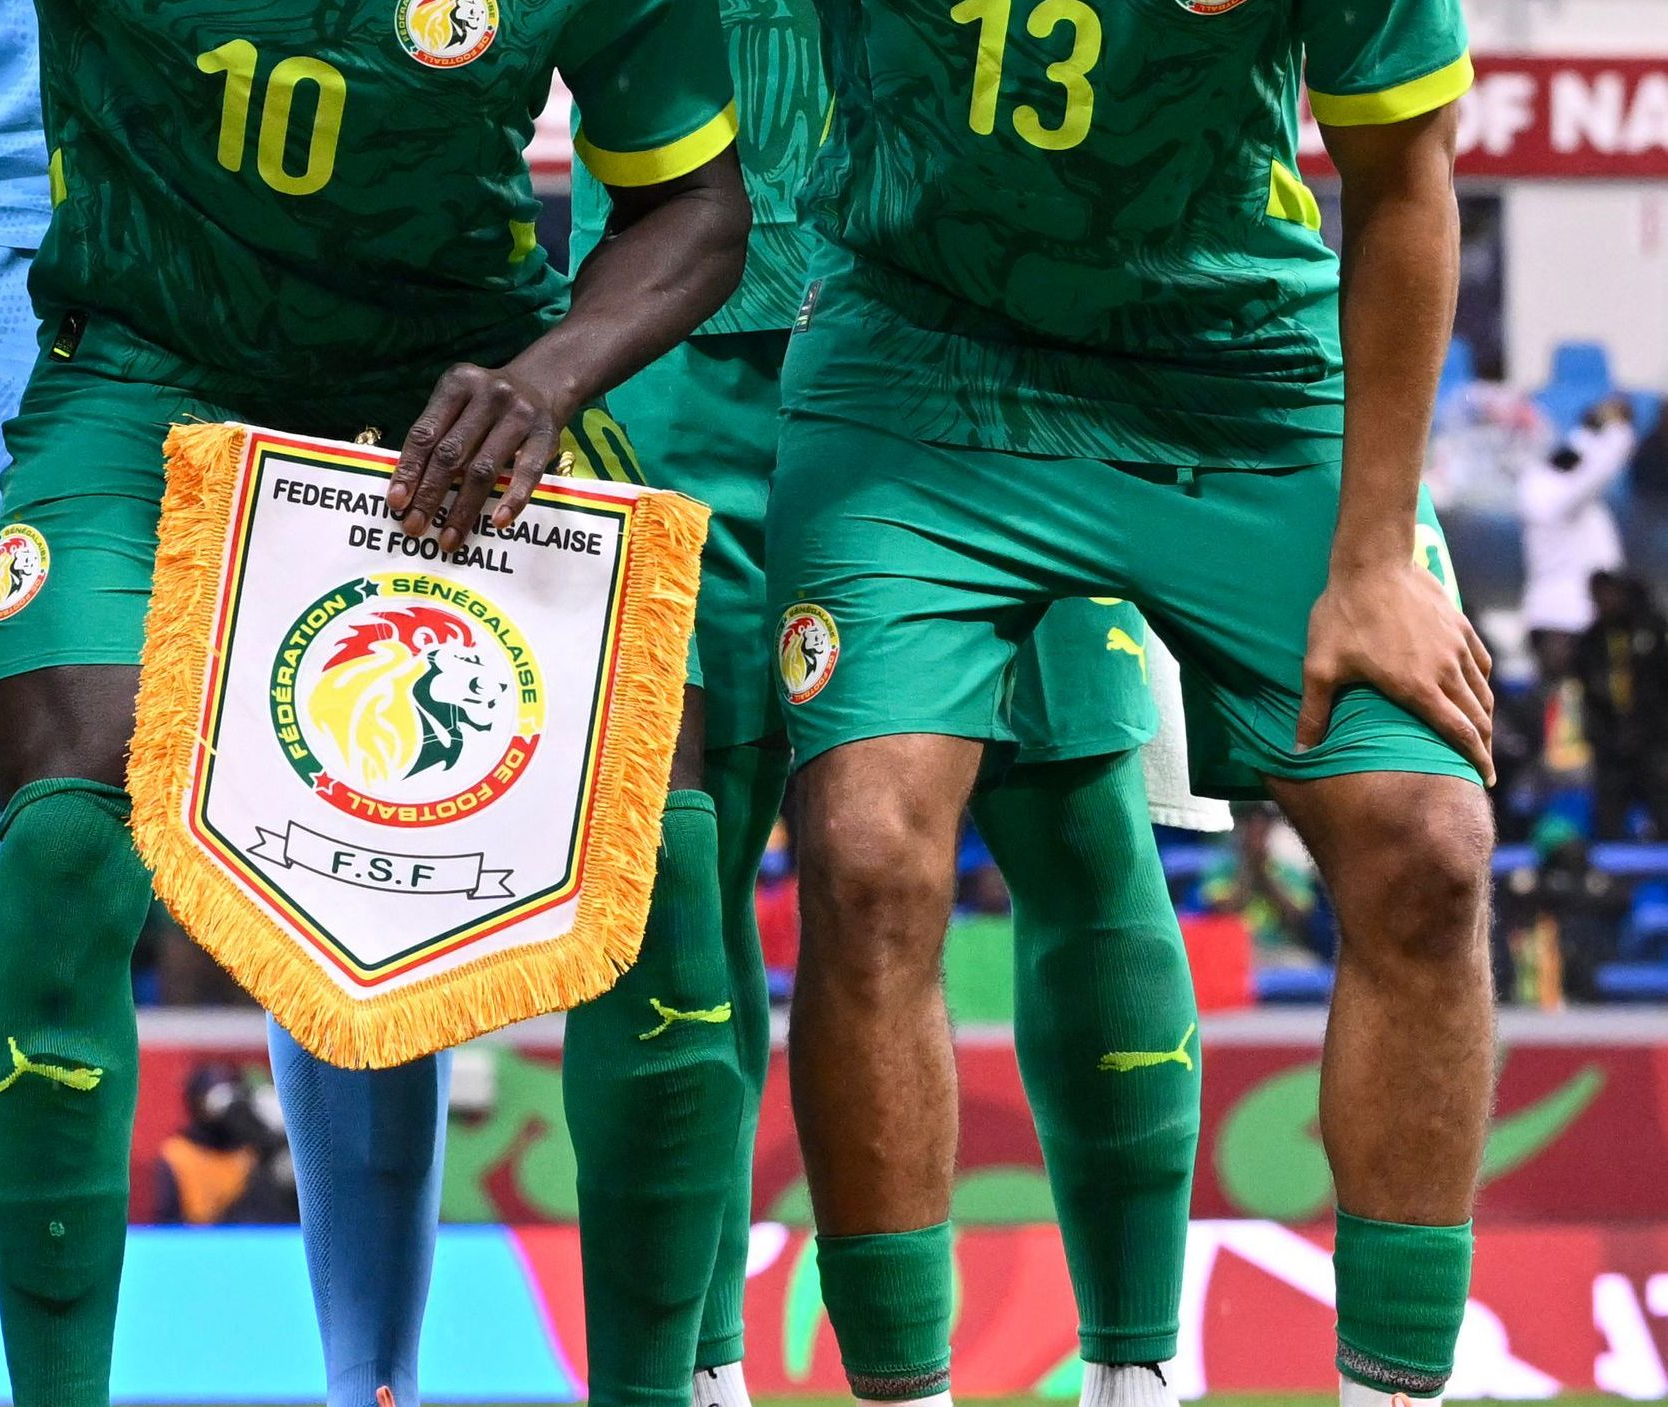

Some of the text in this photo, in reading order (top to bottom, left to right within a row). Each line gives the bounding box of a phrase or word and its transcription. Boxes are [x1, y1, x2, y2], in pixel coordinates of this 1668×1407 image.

[196, 39, 347, 196] 10
[272, 478, 603, 556] FEDERATI SEGALAISE
[349, 524, 384, 551] DE
[276, 575, 538, 822] FÉDÉRATION SÉNÉGALAISE DE FOOTBALL
[331, 851, 436, 888] F.S.F
